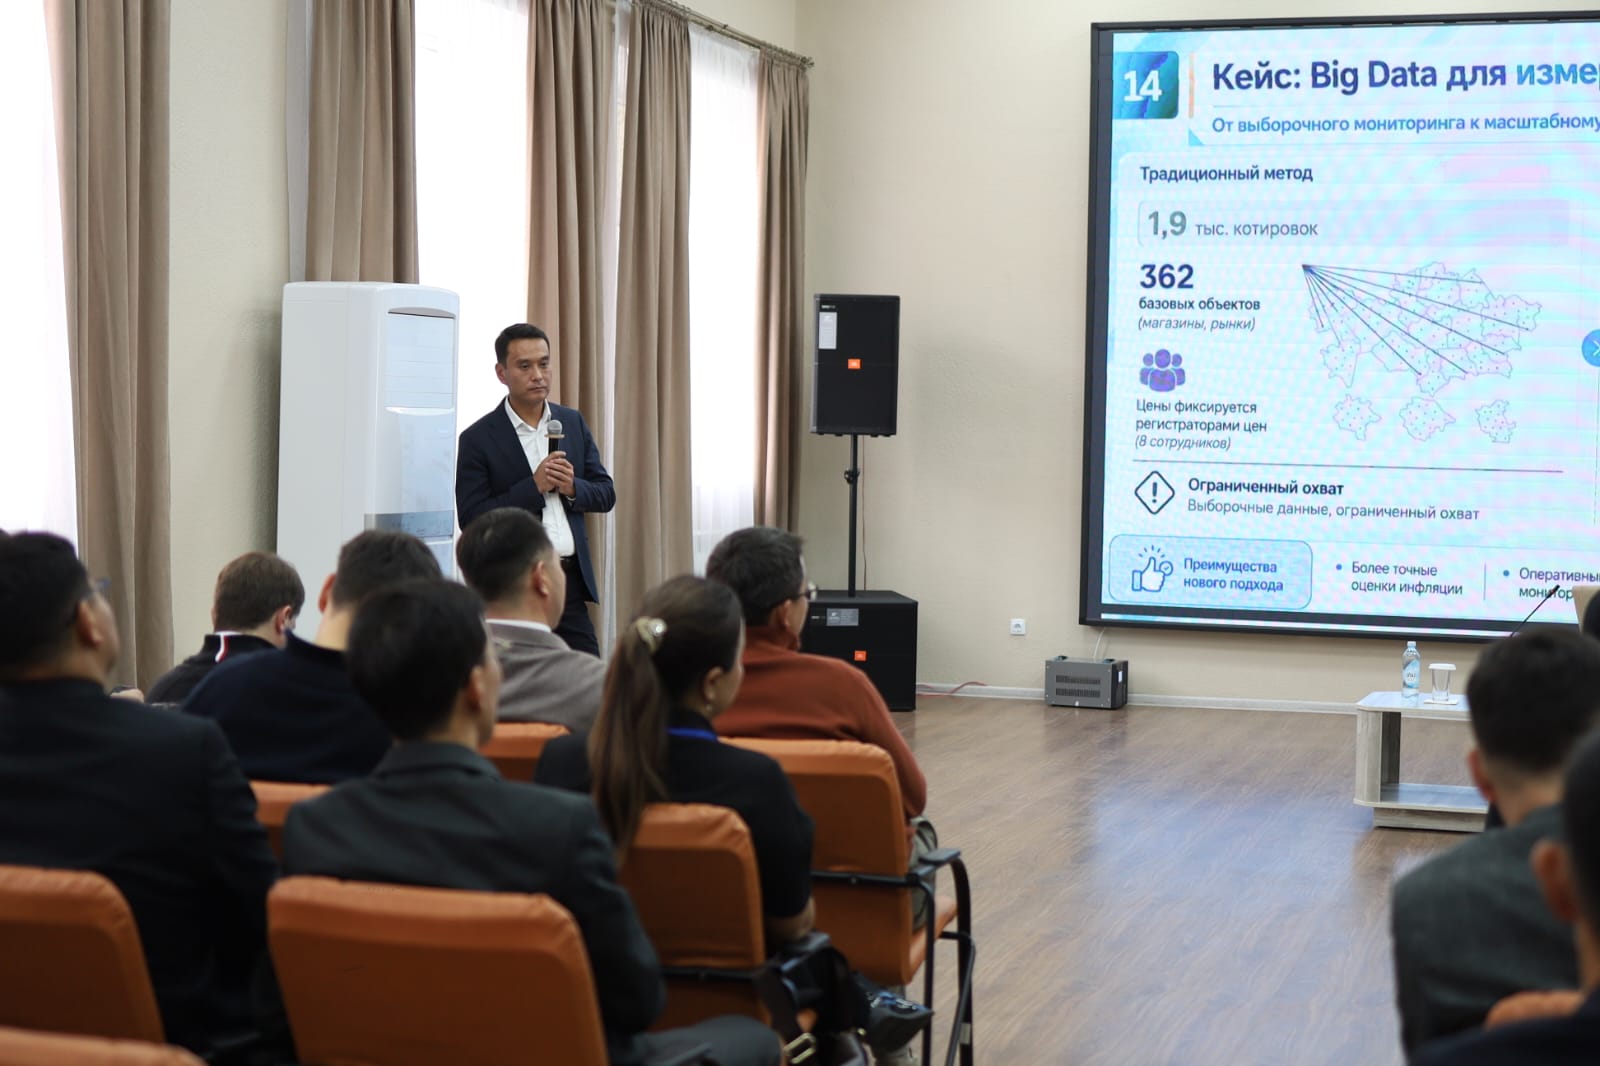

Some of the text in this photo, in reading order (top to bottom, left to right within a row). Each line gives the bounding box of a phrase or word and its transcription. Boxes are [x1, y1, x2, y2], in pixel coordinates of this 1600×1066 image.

[1123, 70, 1162, 102] 14
[1213, 60, 1600, 96] Кейс: Big Data для изме
[1212, 117, 1234, 132] От
[1238, 116, 1350, 136] выборочного
[1354, 117, 1465, 134] мониторинга
[1470, 118, 1480, 129] к
[1140, 165, 1313, 183] Традиционный метод
[1148, 211, 1318, 240] 1,9 тыс. котировок
[1139, 263, 1194, 289] 362
[1138, 297, 1261, 310] базовых объектов
[1138, 317, 1256, 332] (магазины, рынки)
[1136, 399, 1257, 415] Цены фиксируется
[1135, 419, 1267, 433] регистраторами цен
[1135, 435, 1231, 451] (8 сотрудников)
[1188, 478, 1344, 495] Ограниченный охват
[1188, 499, 1479, 520] Выборочные данные, ограниченный охват
[1184, 558, 1277, 573] Преимущества
[1352, 561, 1437, 576] Более точные
[1519, 567, 1600, 583] Оперативны
[1184, 578, 1283, 592] нового подхода
[1351, 580, 1463, 596] оценки инфляции
